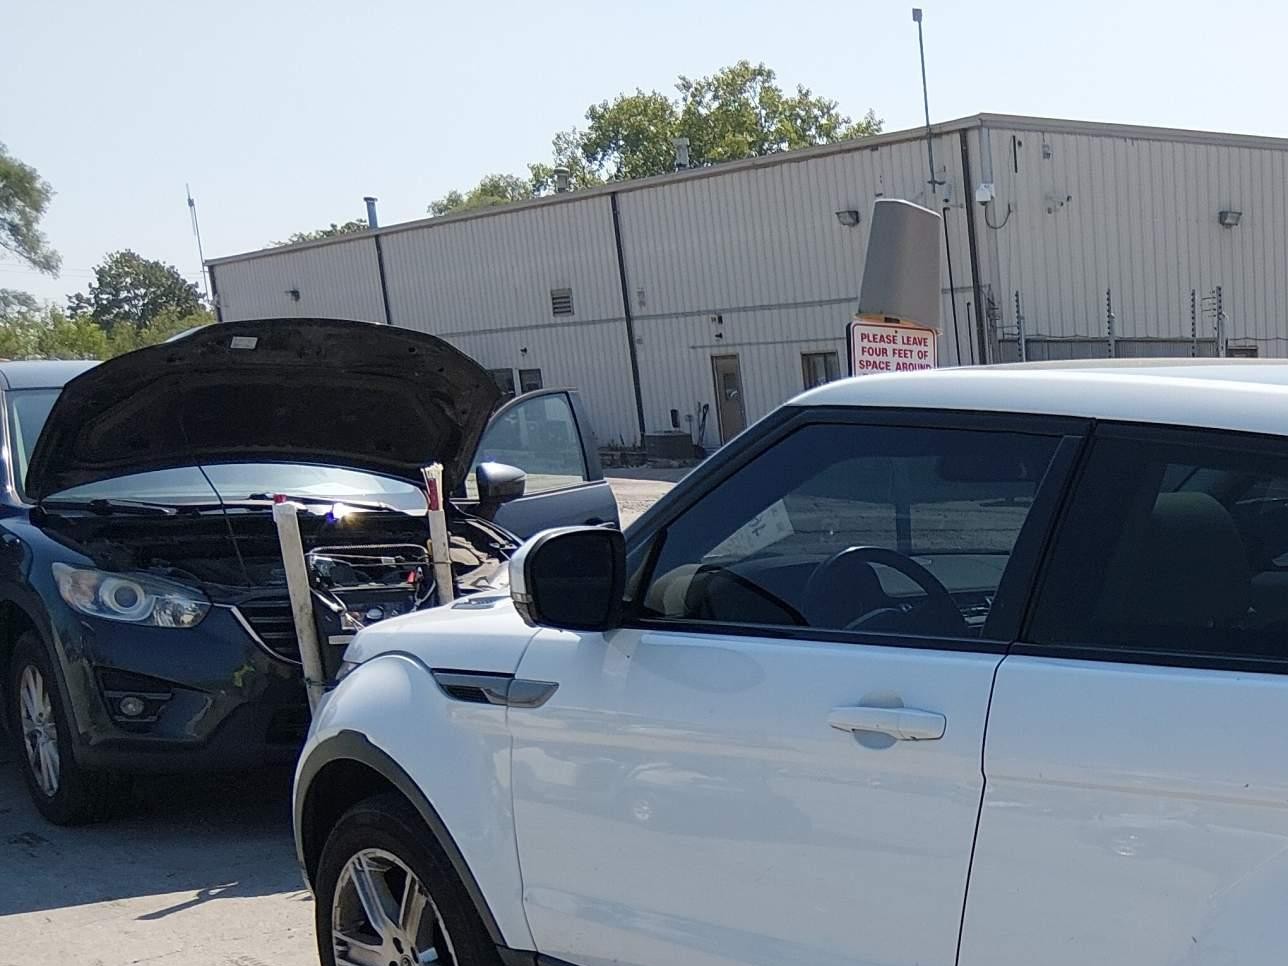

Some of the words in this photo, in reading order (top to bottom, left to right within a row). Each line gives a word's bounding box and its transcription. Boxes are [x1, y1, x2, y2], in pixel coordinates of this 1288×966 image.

[861, 333, 898, 345] PLEASE
[902, 336, 928, 347] LEAVE
[861, 346, 888, 357] FOUR
[893, 348, 914, 359] FEET
[917, 350, 929, 361] OF
[859, 360, 891, 371] SPACE
